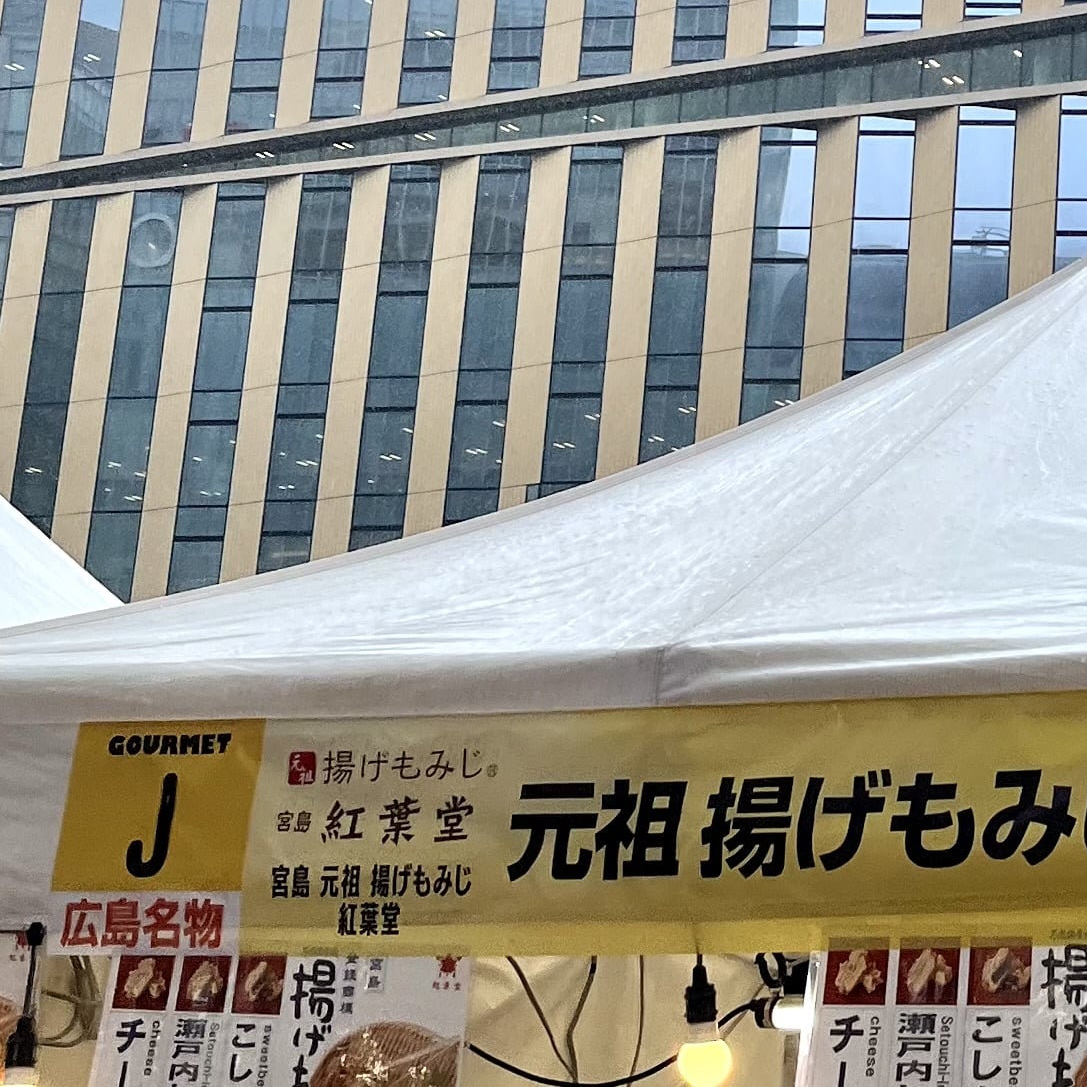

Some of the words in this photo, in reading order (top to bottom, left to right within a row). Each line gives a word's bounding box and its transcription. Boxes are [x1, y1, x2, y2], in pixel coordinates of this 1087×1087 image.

[108, 733, 232, 756] GOURMET
[322, 748, 482, 785] 揚げもみじ
[125, 772, 178, 878] J
[277, 810, 312, 833] 宮島
[320, 795, 474, 846] 紅葉堂
[507, 777, 680, 882] 元祖
[271, 864, 310, 899] 宮島
[319, 864, 361, 898] 元祖
[370, 863, 472, 898] 揚げもみじ
[60, 897, 225, 949] 広島名物
[337, 902, 401, 936] 紅葉堂
[169, 1018, 208, 1087] 瀬戸内
[865, 1016, 882, 1077] cheese
[895, 1013, 937, 1087] 瀬戸内
[937, 1015, 954, 1087] Setouchi-l
[971, 1016, 1003, 1087] こし
[1009, 1017, 1022, 1087] sweetbe
